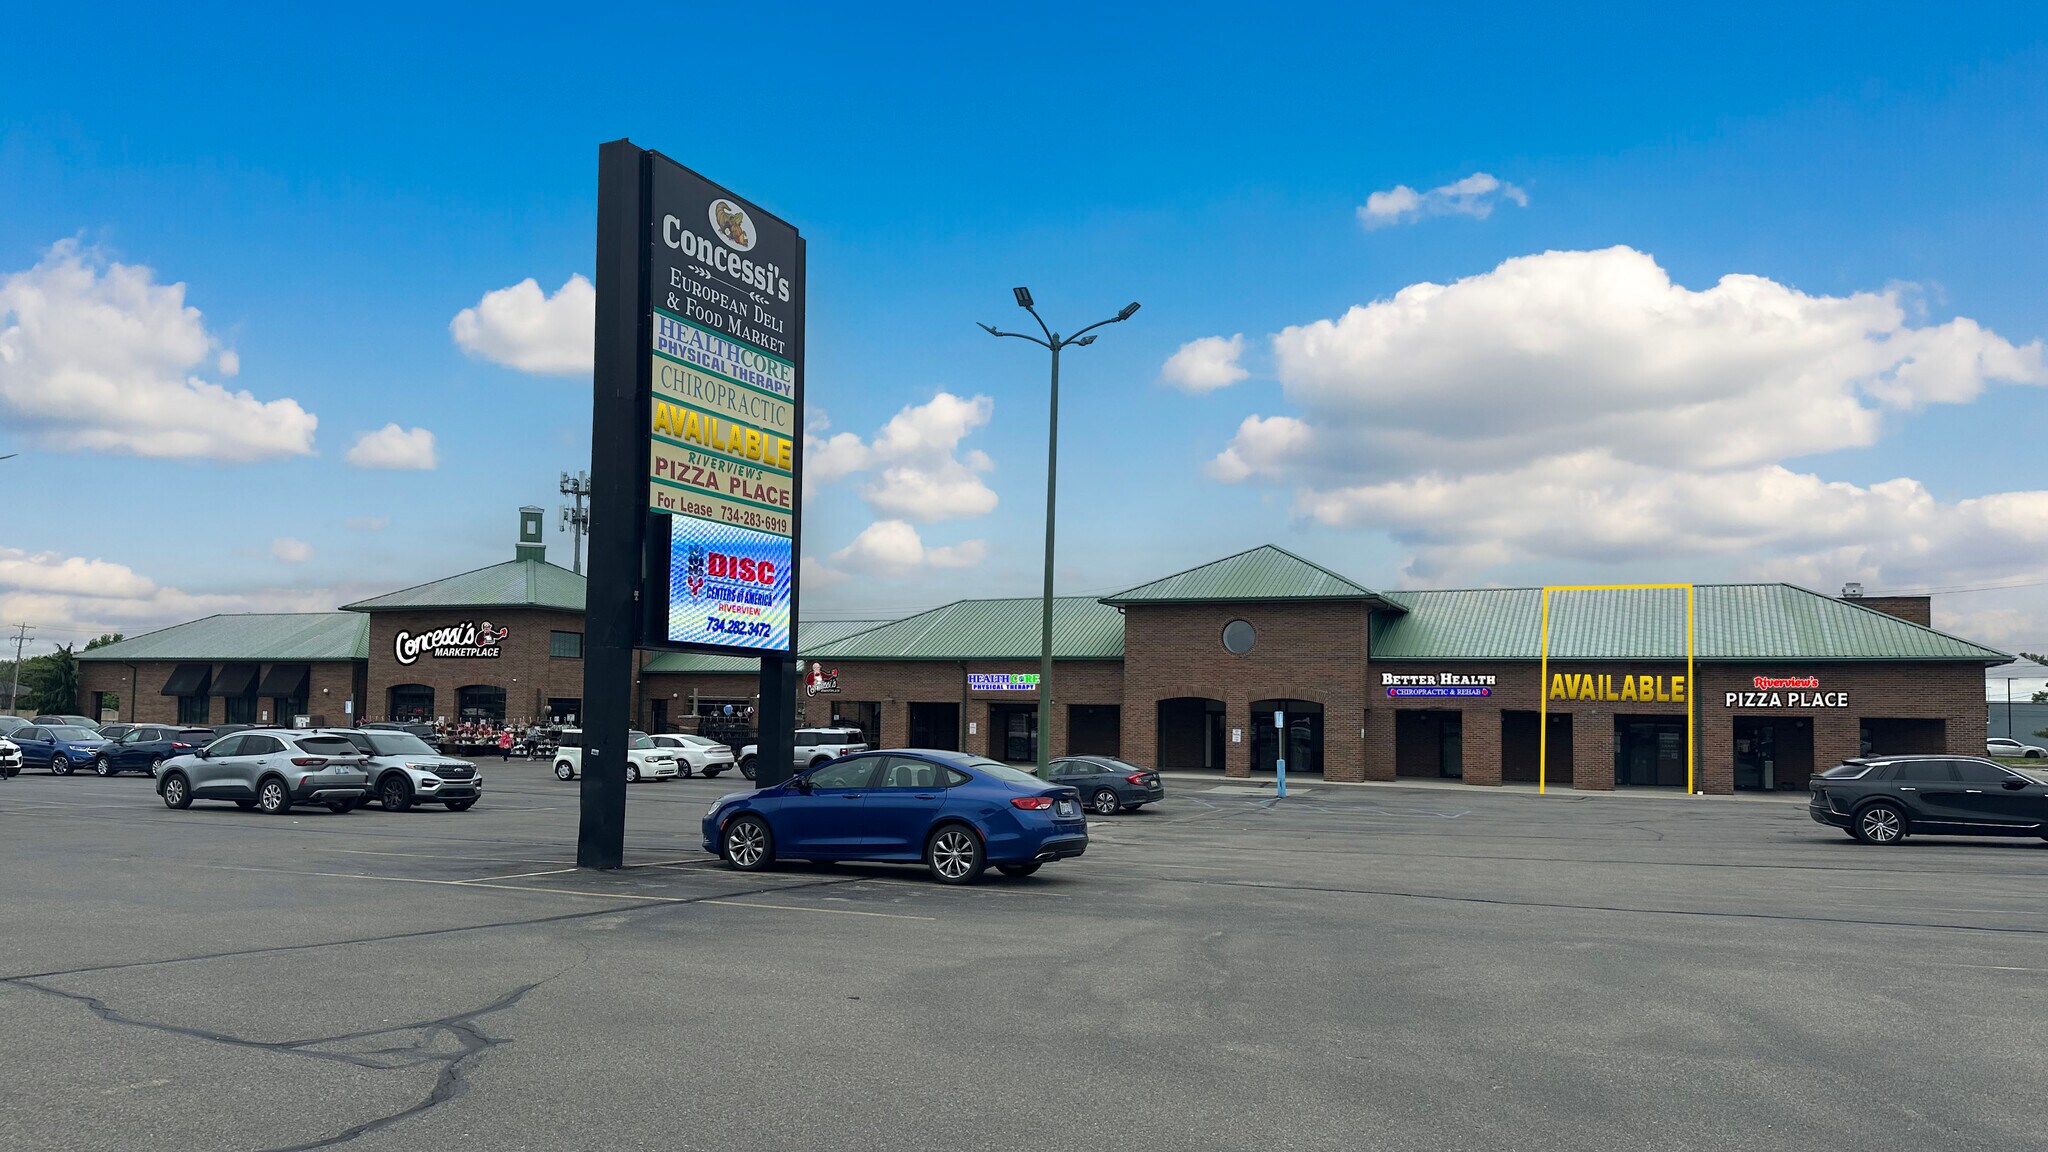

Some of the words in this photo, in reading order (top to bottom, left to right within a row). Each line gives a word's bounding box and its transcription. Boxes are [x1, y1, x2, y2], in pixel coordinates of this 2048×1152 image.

[663, 214, 790, 302] Concessi's
[670, 267, 748, 317] EUROPEAN
[754, 305, 783, 333] DELI
[666, 291, 680, 311] &
[686, 297, 723, 328] FOOD
[728, 315, 785, 354] MARKET
[658, 337, 728, 375] PHYSICAL
[731, 363, 791, 396] THERAPY
[659, 315, 791, 383] HEALTHCORE
[661, 365, 786, 427] CHIROPRACTIC
[655, 456, 719, 490] PIZZA
[729, 475, 790, 508] PLACE
[688, 451, 763, 481] RIVERVIEW'S
[657, 491, 675, 510] For
[681, 497, 713, 517] Lease
[720, 505, 787, 533] 734-283-6919
[708, 551, 775, 585] DISC
[706, 586, 736, 602] CENTERS
[744, 590, 773, 607] AMERICA
[718, 603, 762, 615] RIVERVIEW
[396, 622, 475, 664] Concessi's
[706, 616, 772, 638] 734.282.3472
[434, 647, 500, 657] MARKETPLACE
[1381, 673, 1436, 685] BETTER
[1440, 673, 1496, 685] HEALTH
[1754, 676, 1819, 690] Riverview's
[1726, 692, 1783, 707] PIZZA
[1787, 692, 1848, 707] PLACE
